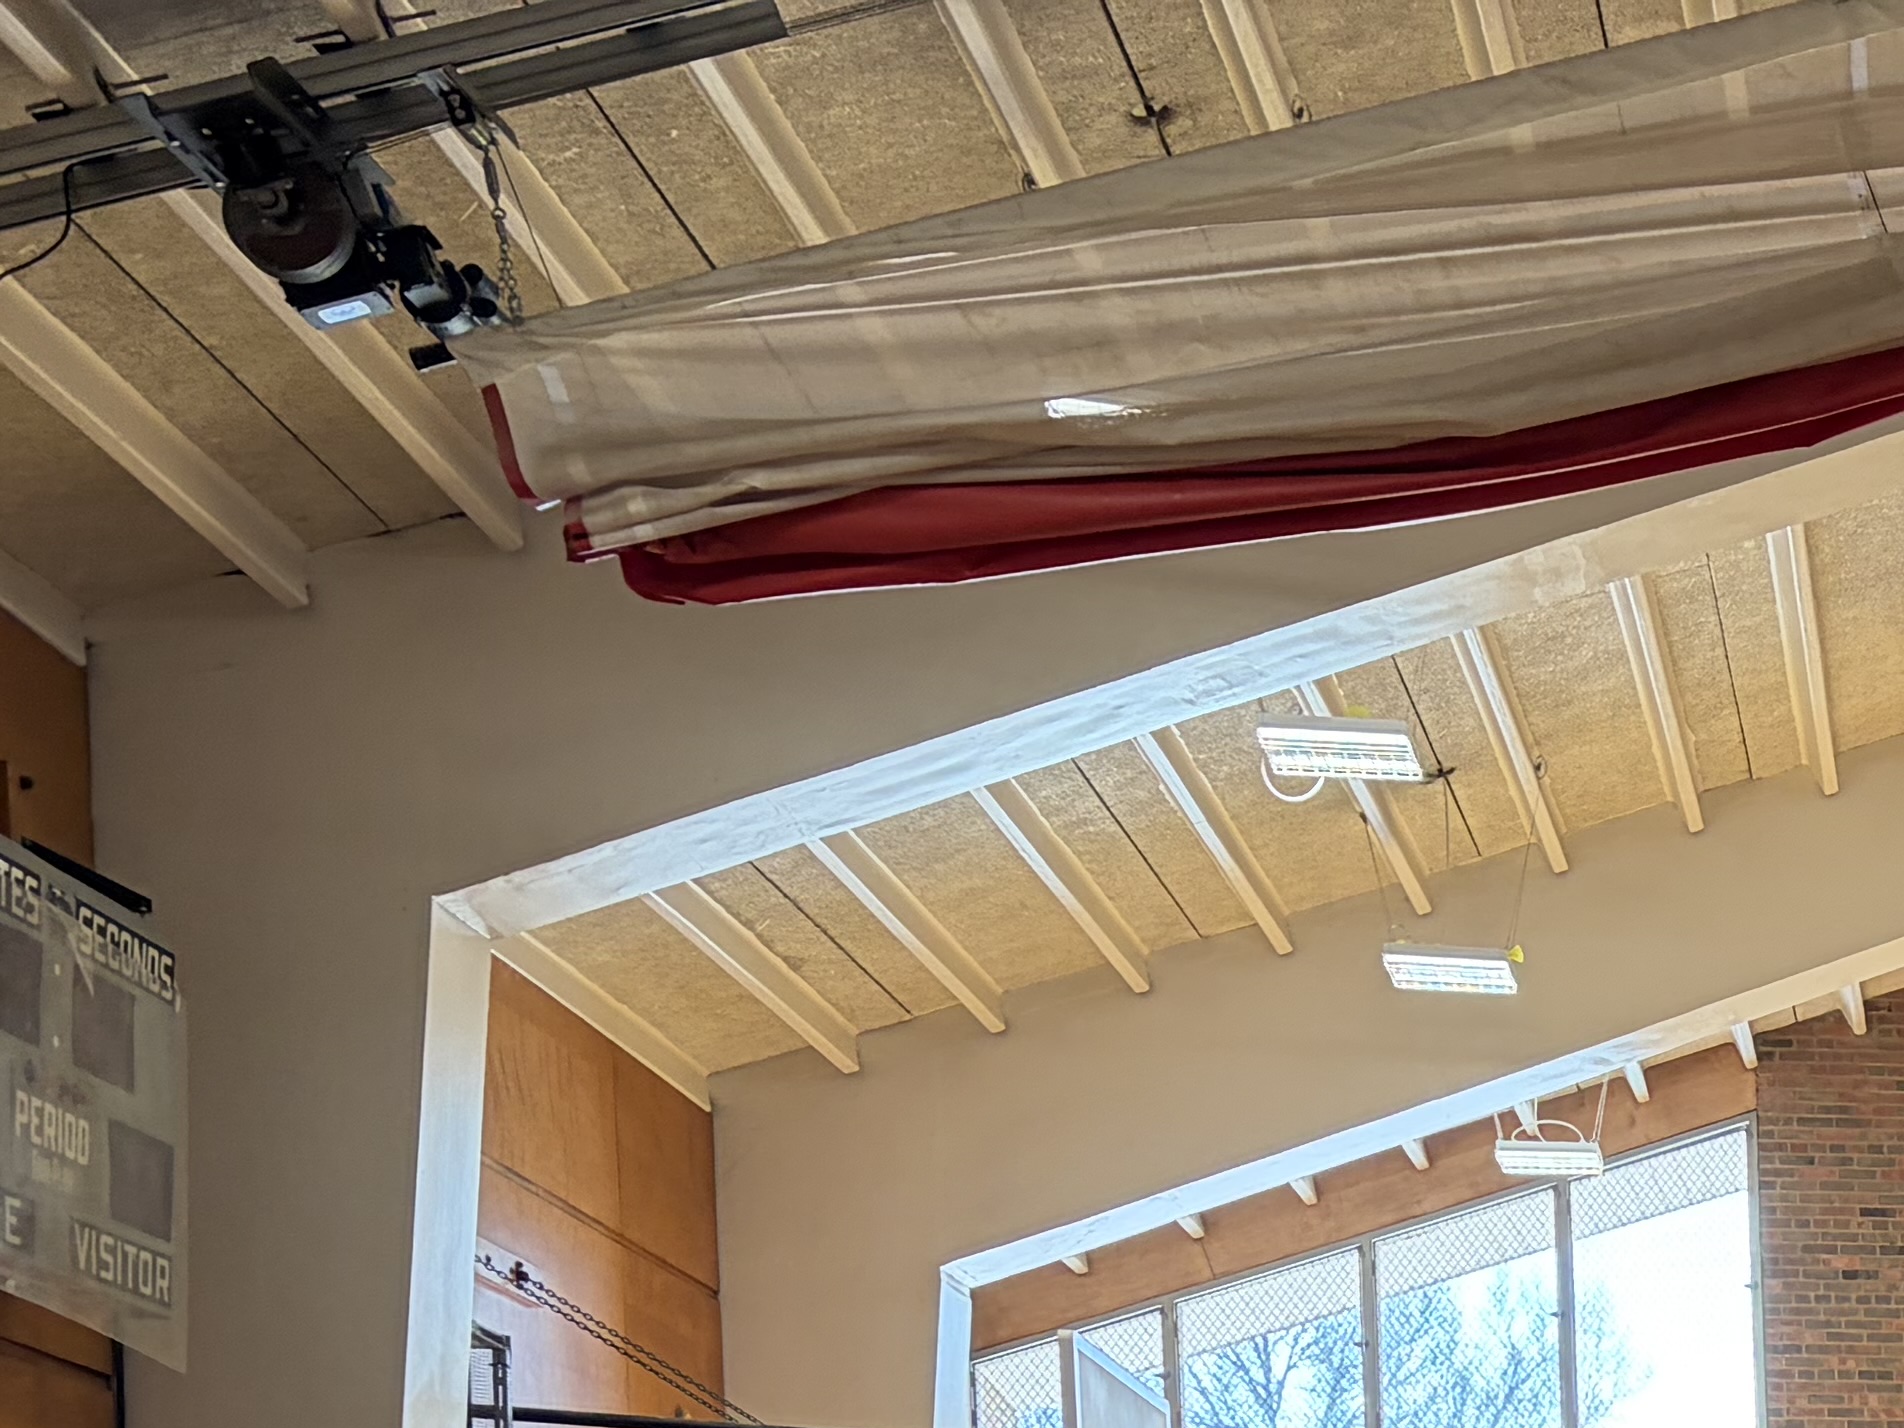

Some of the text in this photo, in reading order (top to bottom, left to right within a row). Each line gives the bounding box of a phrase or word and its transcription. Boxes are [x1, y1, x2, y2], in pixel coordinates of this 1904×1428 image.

[78, 905, 174, 1001] SECONDS
[15, 1089, 90, 1166] PERIOD
[74, 1222, 171, 1303] VISITOR
